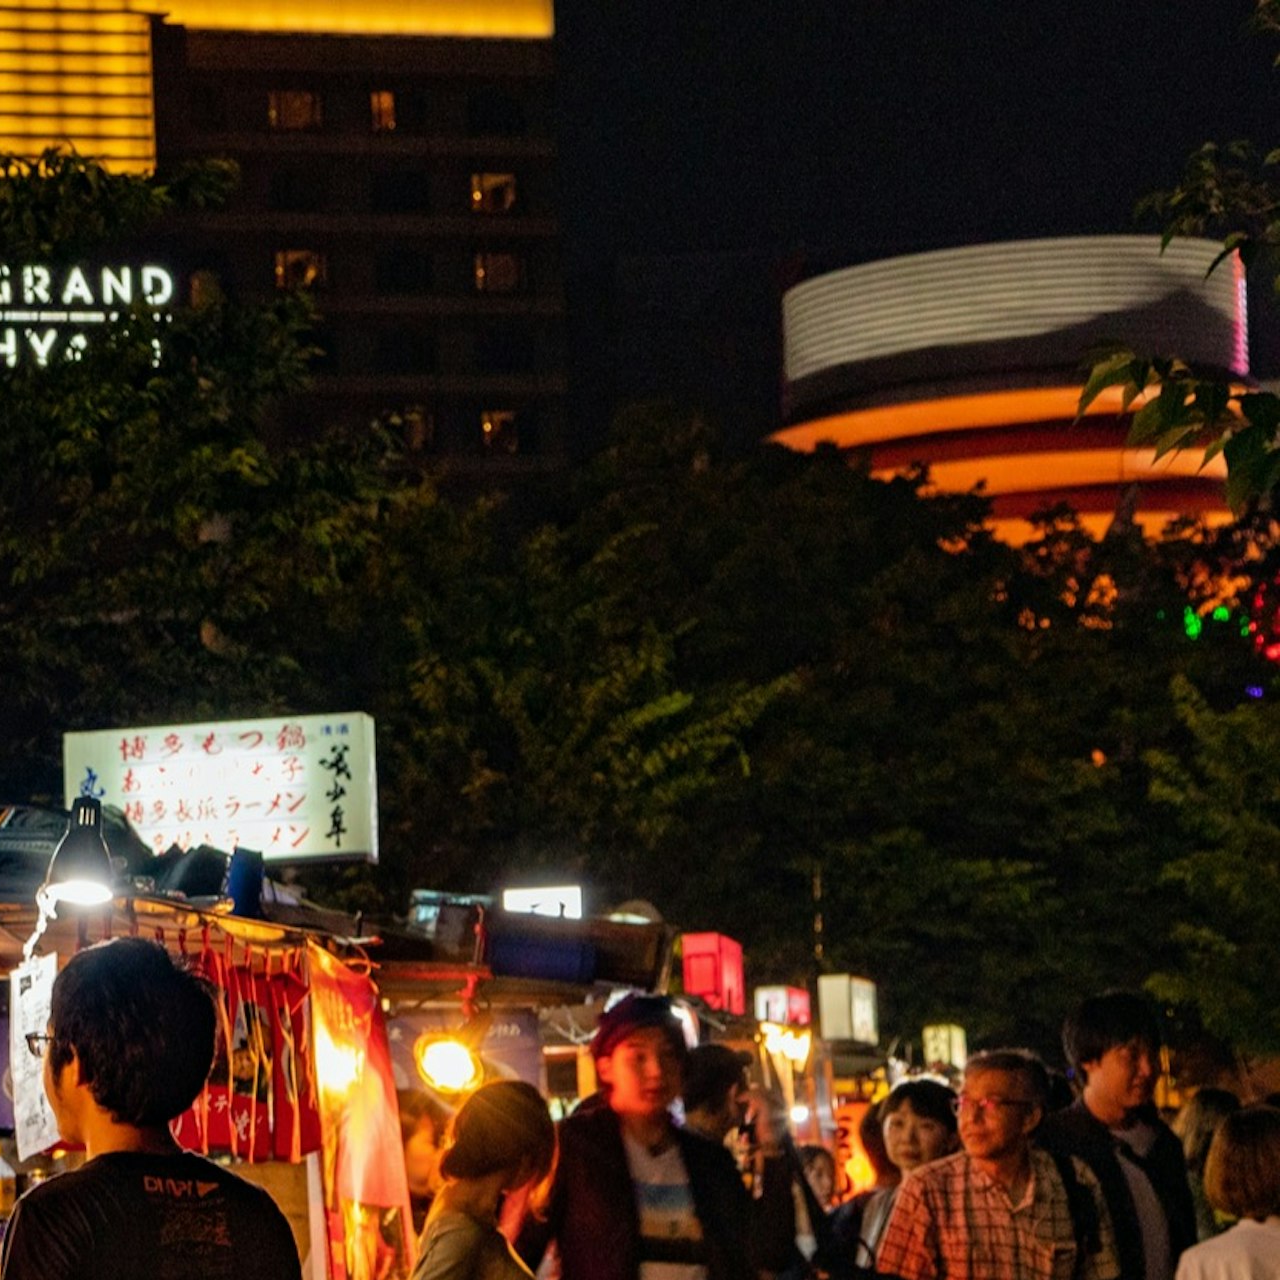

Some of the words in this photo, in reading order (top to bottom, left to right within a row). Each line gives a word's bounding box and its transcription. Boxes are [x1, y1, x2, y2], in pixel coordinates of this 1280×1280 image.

[119, 723, 307, 763] 博多もつ鍋
